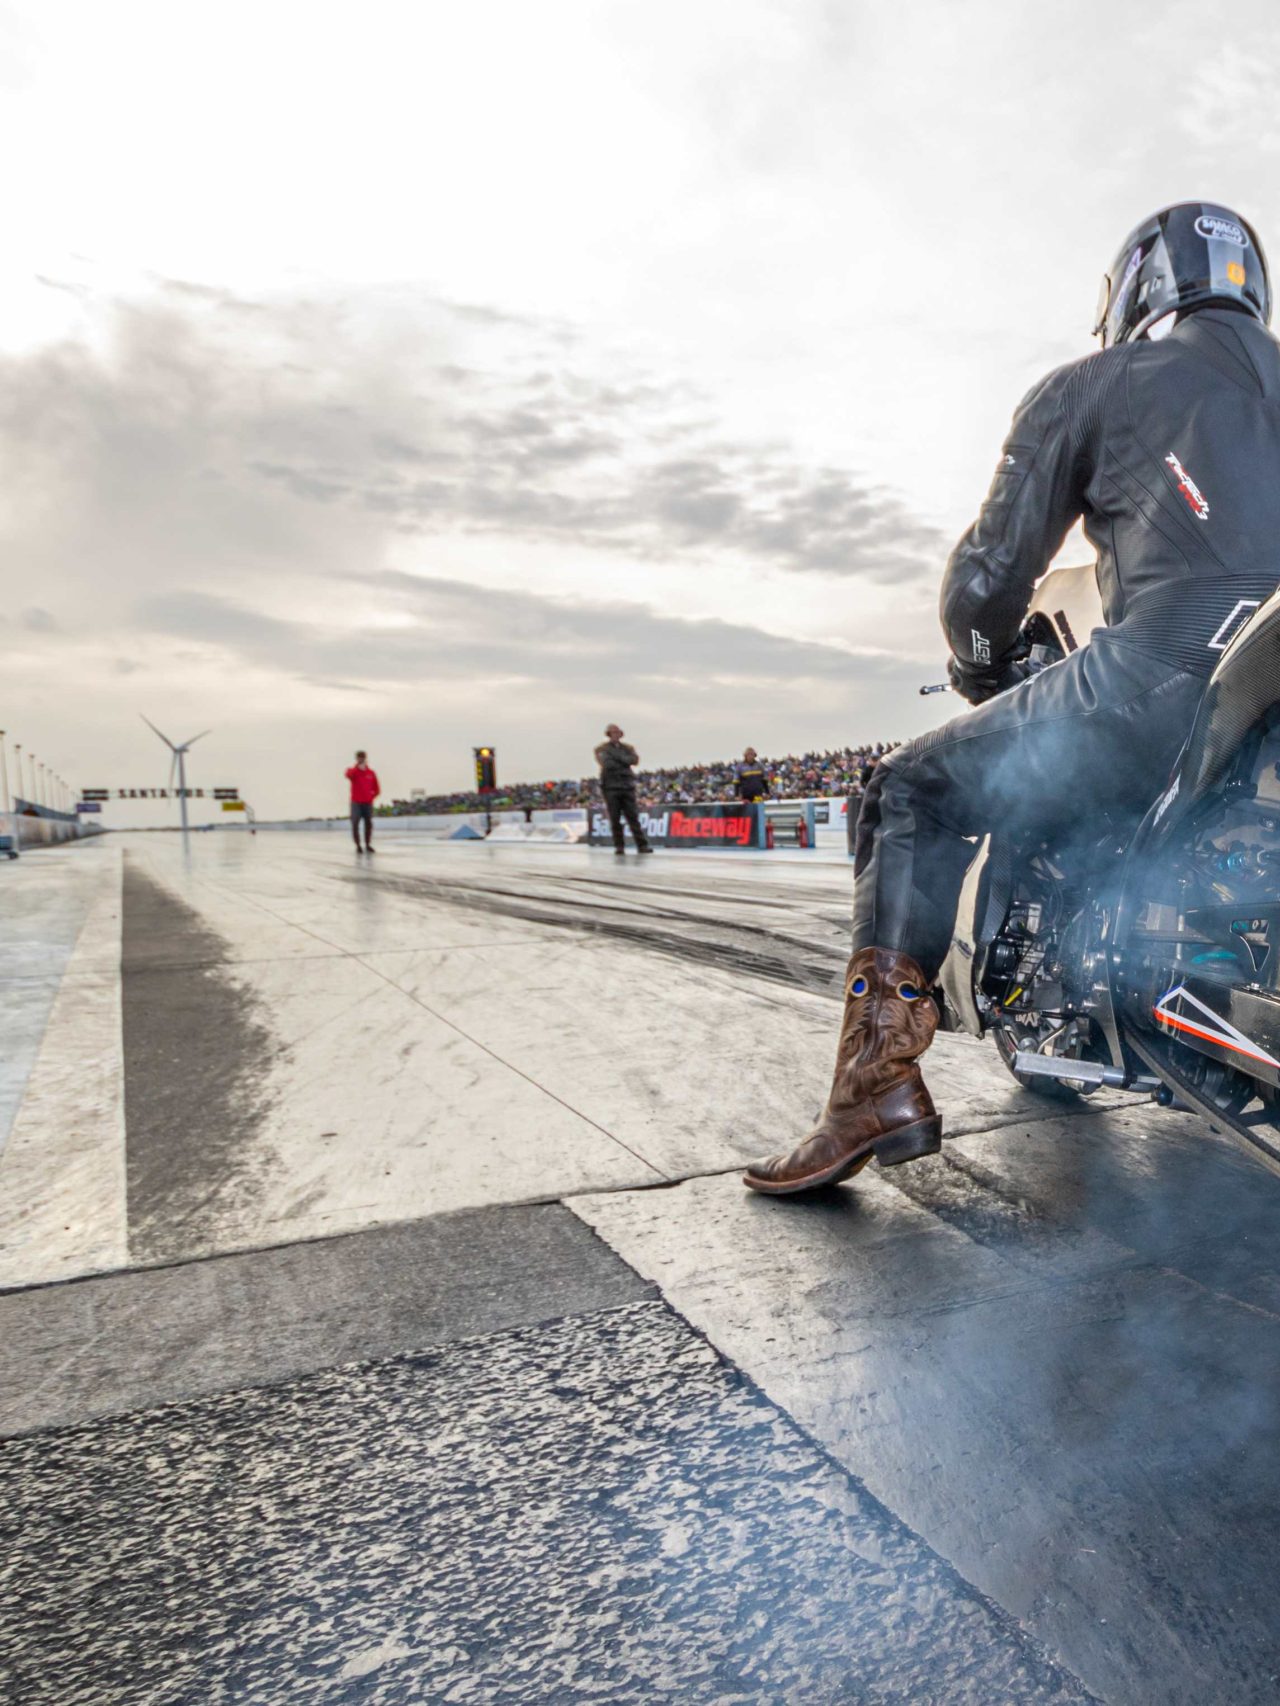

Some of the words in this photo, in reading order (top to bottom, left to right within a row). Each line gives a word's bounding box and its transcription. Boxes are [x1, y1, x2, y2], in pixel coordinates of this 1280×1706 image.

[971, 628, 992, 665] RST
[118, 788, 169, 799] SANTA
[669, 810, 753, 845] Raceway
